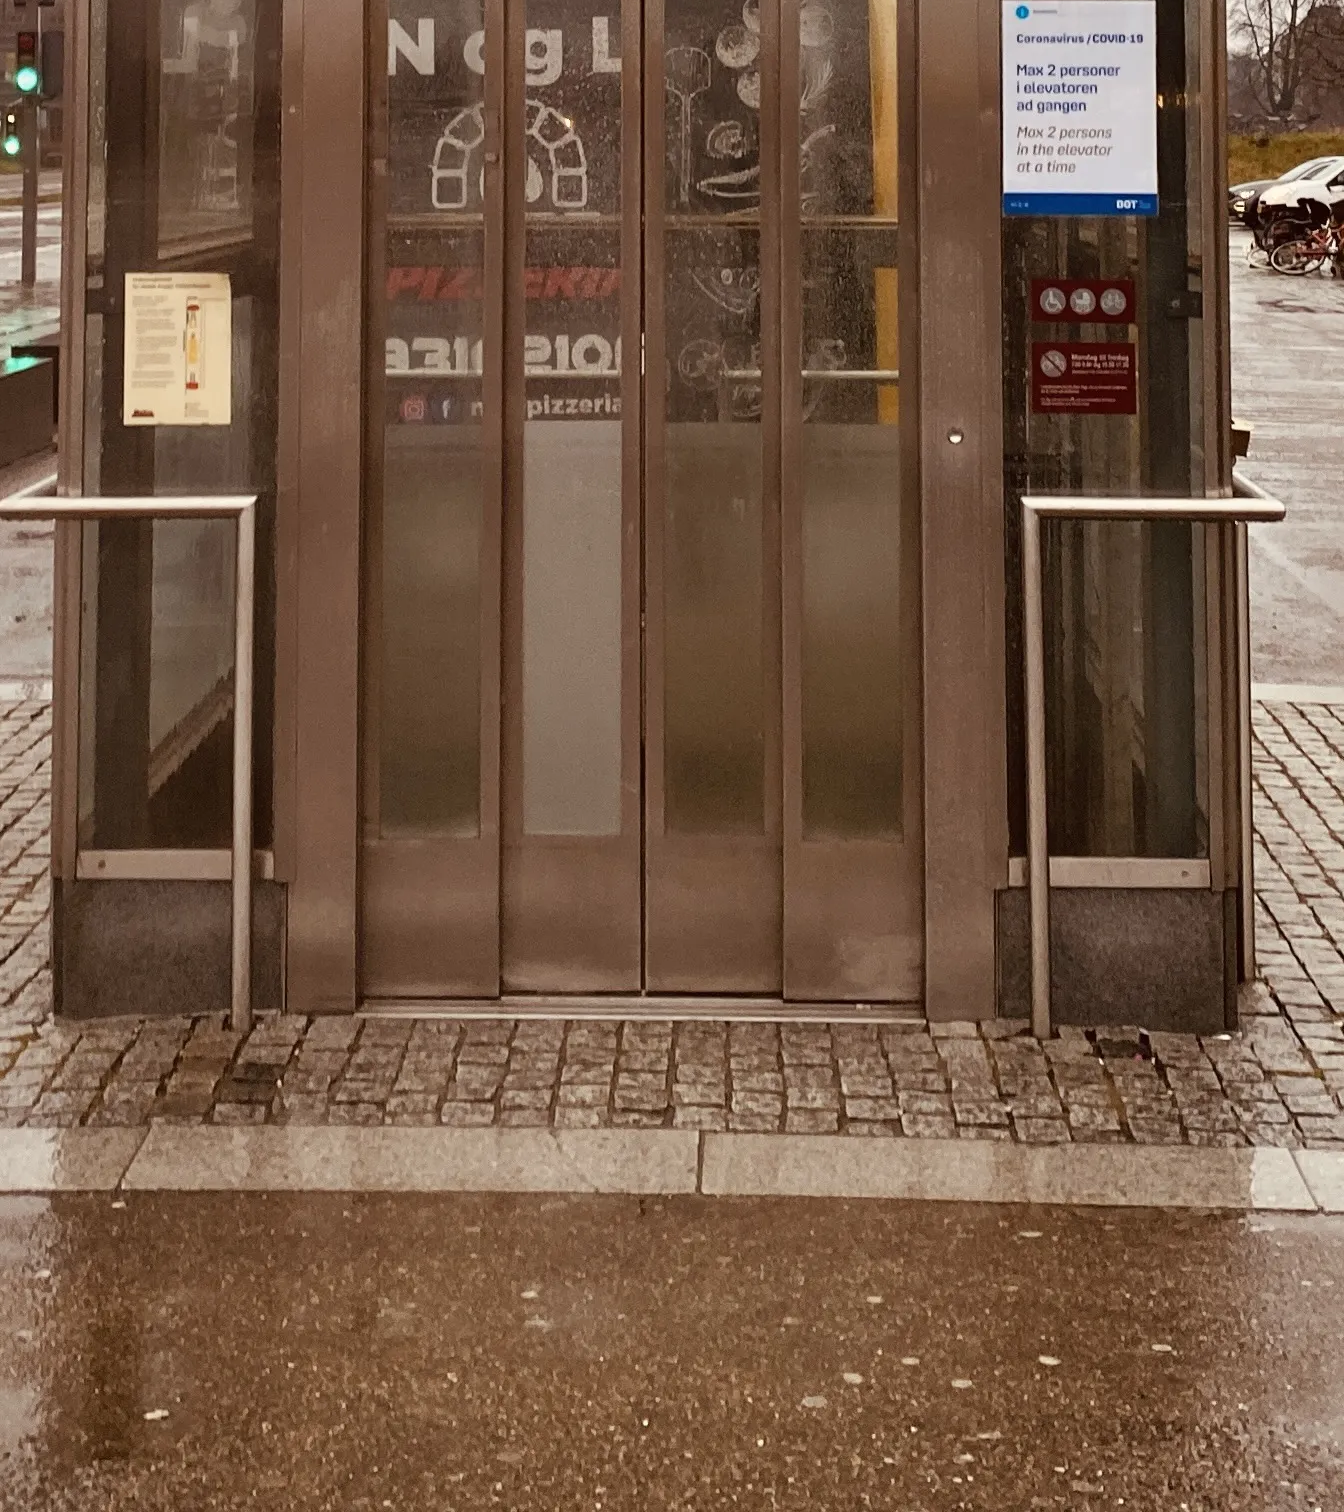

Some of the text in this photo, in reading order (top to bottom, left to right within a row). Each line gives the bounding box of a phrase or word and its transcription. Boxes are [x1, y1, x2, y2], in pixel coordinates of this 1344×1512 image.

[1016, 33, 1084, 44] Coronavirus
[1016, 64, 1121, 79] Max 2 personer
[1023, 81, 1098, 94] elevatoren
[1016, 100, 1087, 114] ad gangen
[1016, 125, 1112, 141] Max 2 persons
[1016, 142, 1113, 157] in the elevator
[1016, 160, 1076, 173] at a time
